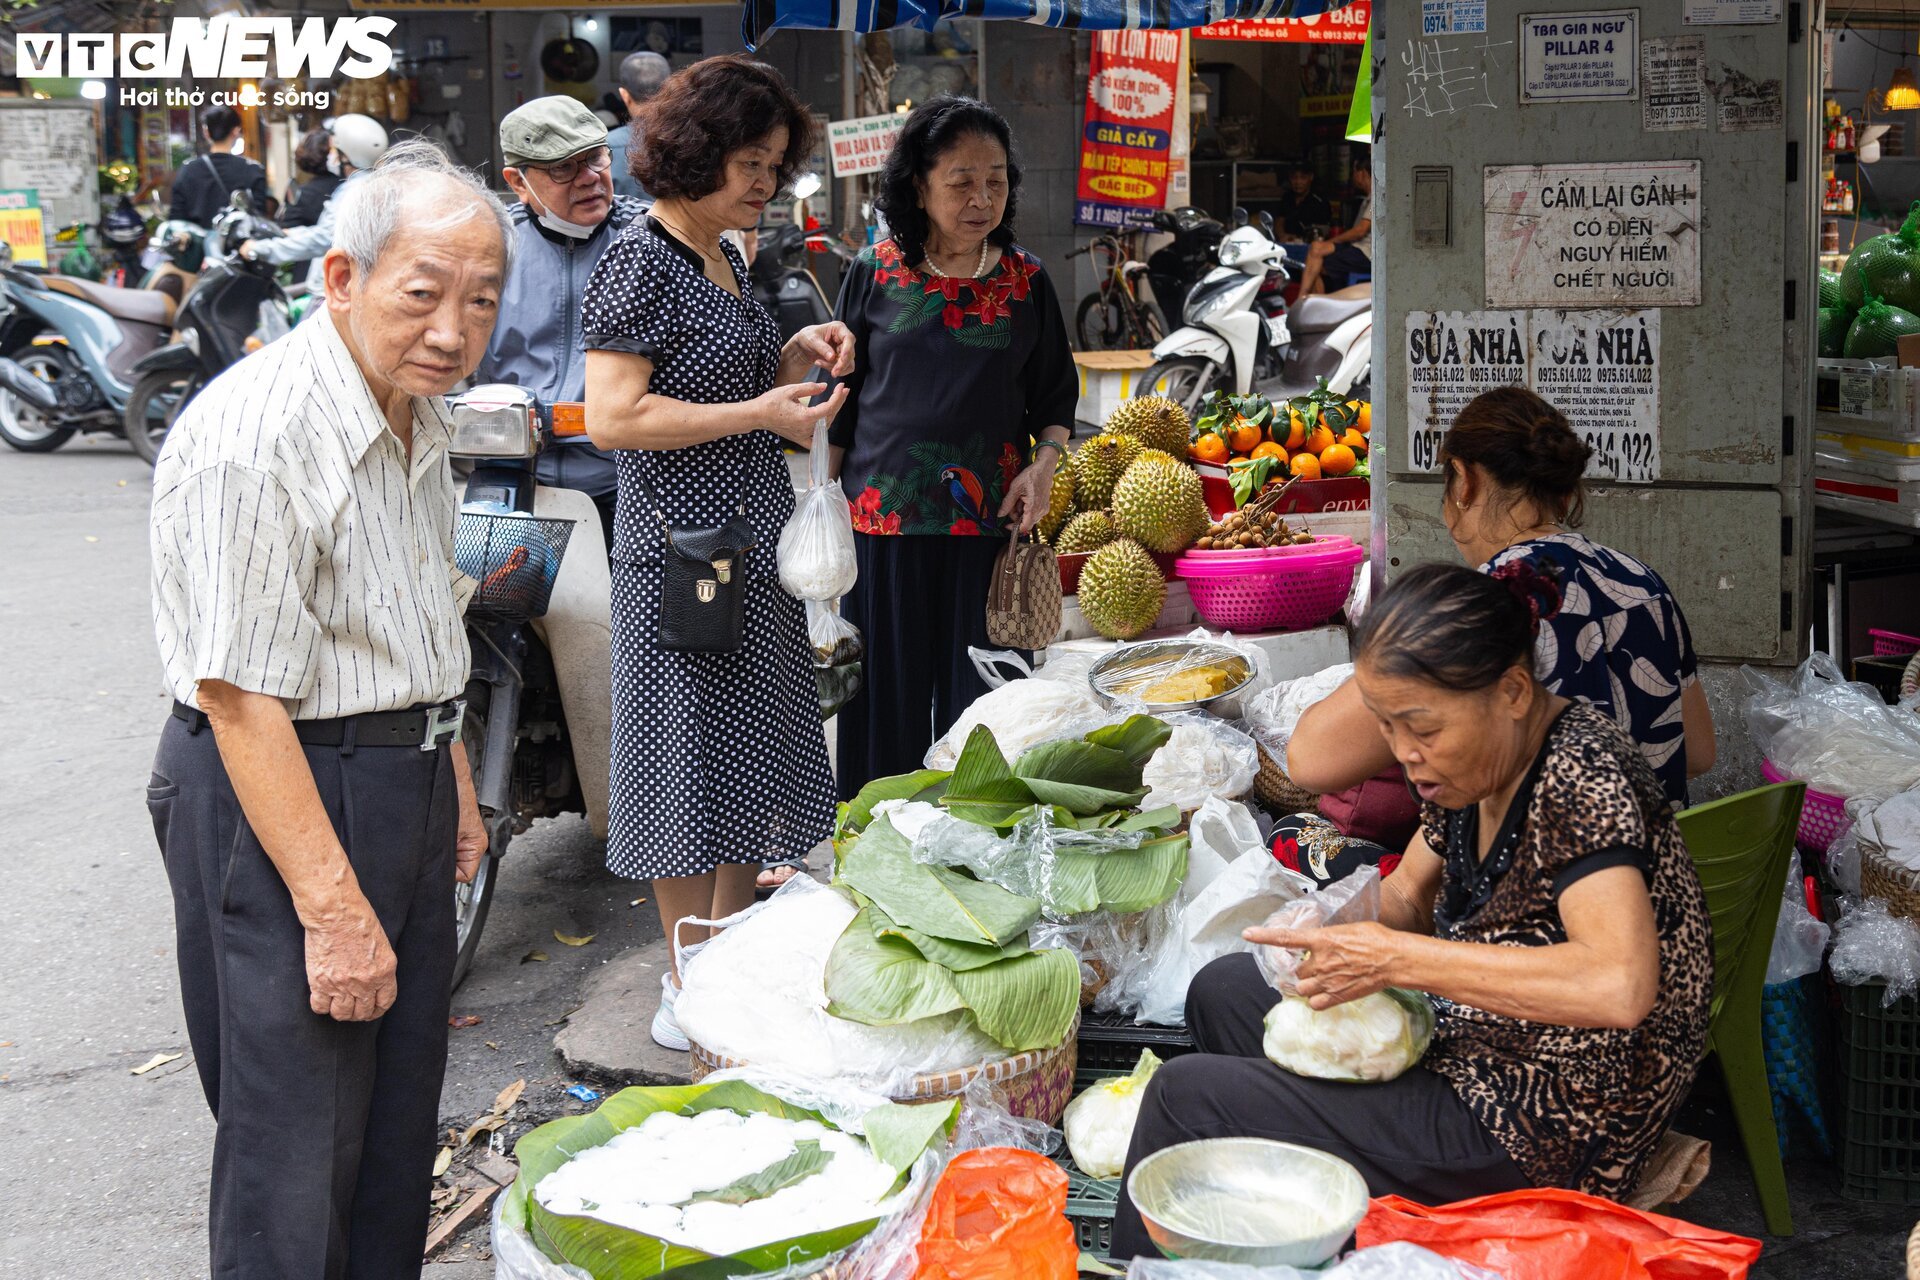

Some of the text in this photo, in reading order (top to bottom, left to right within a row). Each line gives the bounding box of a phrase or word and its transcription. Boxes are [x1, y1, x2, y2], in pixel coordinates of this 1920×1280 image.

[1330, 6, 1366, 28] ĐẶC
[1232, 23, 1238, 36] 1
[1533, 21, 1626, 36] TBA GIA NGƯ
[1544, 40, 1614, 56] PILLAR 4
[1560, 72, 1576, 80] PILLAR
[1582, 80, 1600, 88] PILLAR
[1650, 106, 1700, 119] 0971.973.813
[834, 141, 852, 158] MUA
[853, 136, 870, 155] BÁN
[837, 159, 857, 172] DAO
[1541, 176, 1688, 212] CẤM LẠI GẦN !
[1080, 203, 1096, 221] SỐ
[1096, 208, 1102, 222] 1
[1574, 217, 1653, 240] CÓ ĐIỆN
[1560, 238, 1668, 262] NGUY HIỂM
[1554, 267, 1674, 288] CHẾT NGƯỜI
[1410, 314, 1525, 365] SỬA NHÀ
[1596, 317, 1654, 365] NHÀ
[1413, 367, 1522, 382] 0975.614.022 0975.614.022
[1538, 368, 1652, 382] 0975.614.022 0975.614.022
[1420, 383, 1430, 393] VẤN
[1546, 384, 1556, 394] VẤN
[1558, 384, 1572, 394] THIẾT
[1592, 386, 1608, 395] CÔNG,
[1609, 385, 1620, 394] SỬA
[1620, 385, 1636, 394] CHỮA
[1636, 385, 1648, 394] NHÀ
[1554, 394, 1572, 405] CHỐNG
[1572, 394, 1588, 406] THẤM,
[1576, 418, 1590, 427] CÔNG
[1592, 420, 1605, 428] TRỌN
[1606, 418, 1616, 427] GÓI
[1625, 420, 1630, 428] A
[1632, 420, 1638, 428] Z
[1414, 430, 1442, 470] 097
